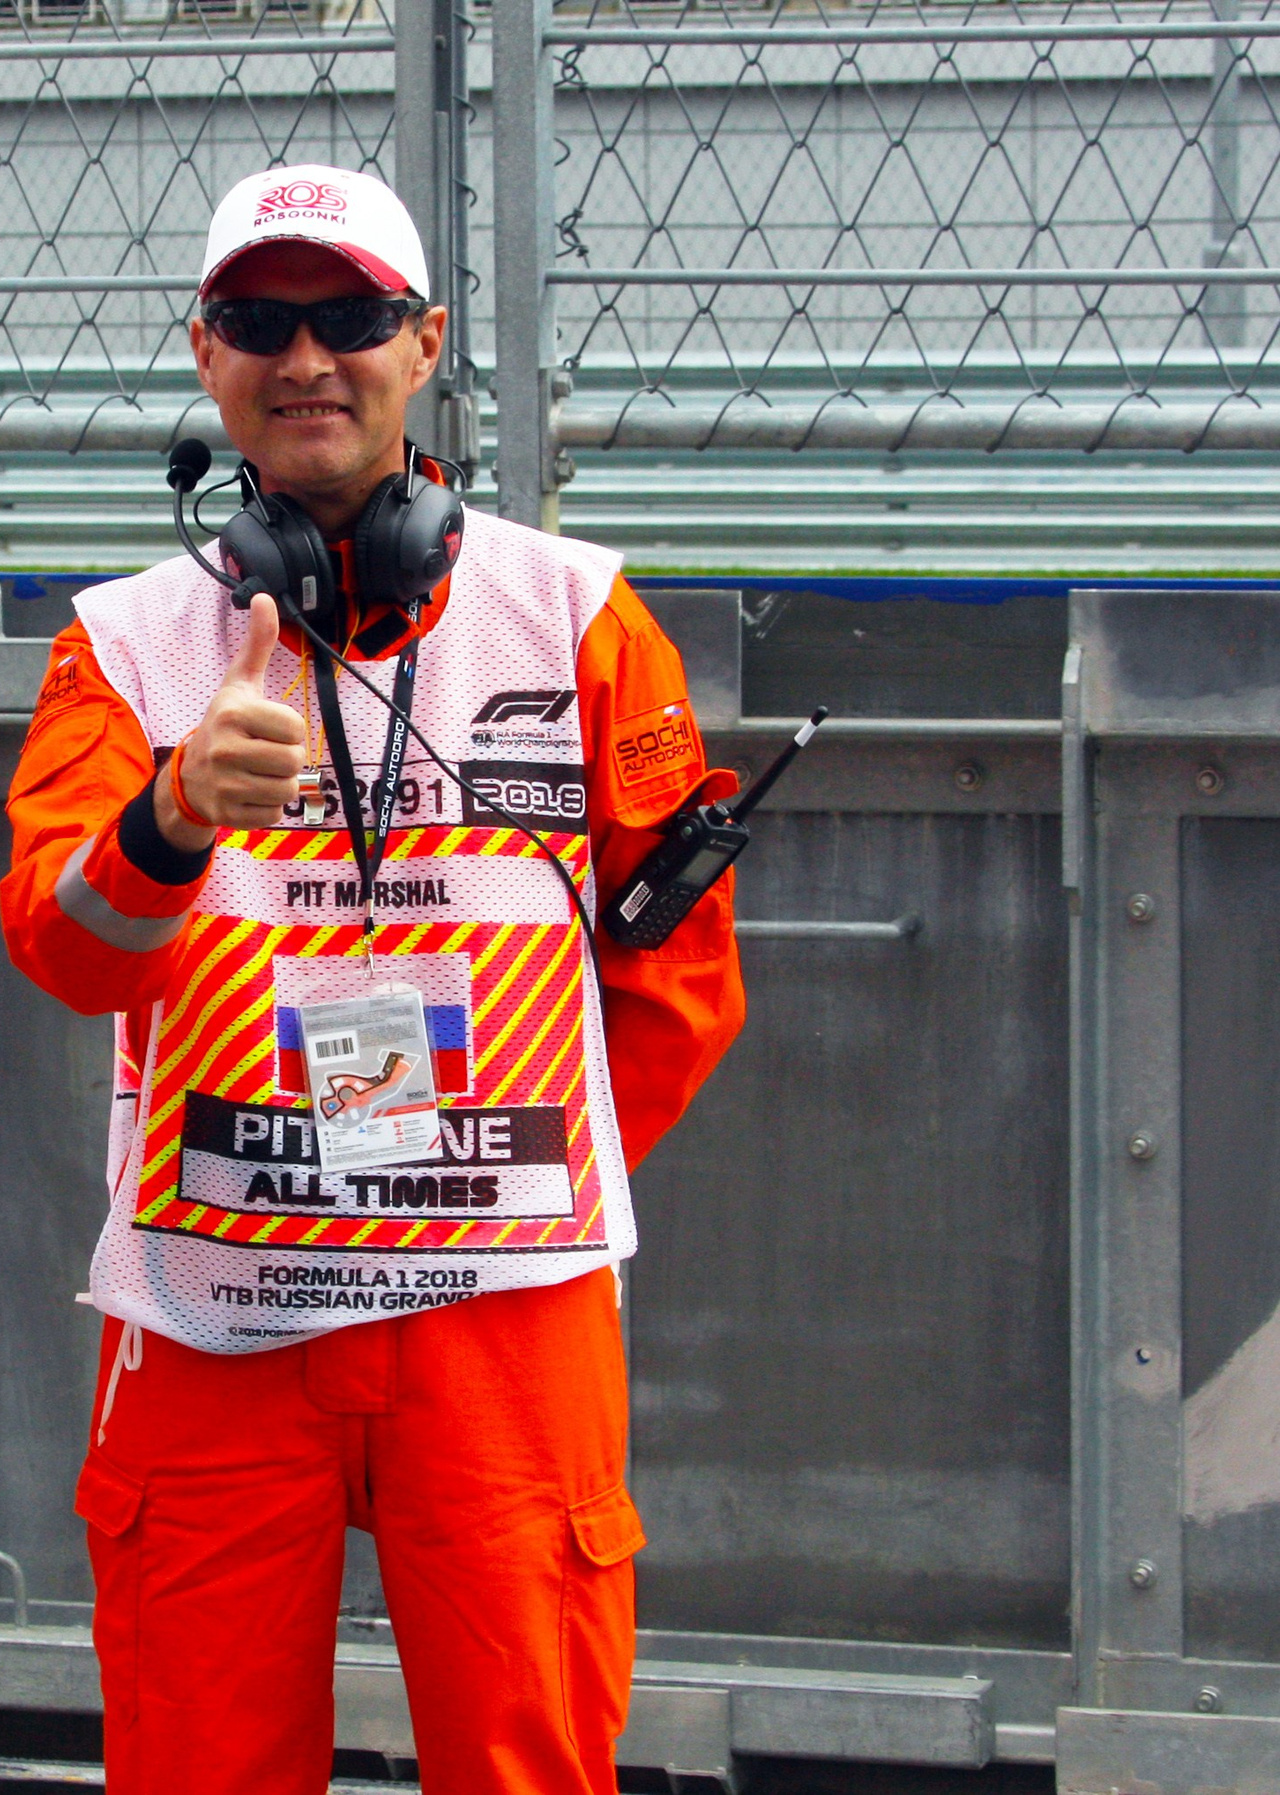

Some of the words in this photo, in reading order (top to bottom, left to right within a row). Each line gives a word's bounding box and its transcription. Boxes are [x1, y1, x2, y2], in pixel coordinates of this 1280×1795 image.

[255, 180, 347, 217] ROS
[616, 720, 689, 761] SOCHI
[623, 741, 694, 775] AUTODROM
[379, 795, 395, 837] SOCHI
[387, 711, 407, 792] AUTODRO
[472, 779, 585, 818] 2018
[287, 881, 326, 908] PIT
[335, 879, 451, 909] MRSHAL
[234, 1112, 315, 1158] PIT
[440, 1117, 512, 1160] NE
[244, 1170, 336, 1205] ALL
[345, 1175, 498, 1208] TIMES
[258, 1265, 391, 1288] FORMULA
[396, 1270, 410, 1288] 1
[414, 1269, 478, 1288] 2018
[210, 1282, 254, 1306] VTB
[258, 1288, 374, 1310] RUSSIAN
